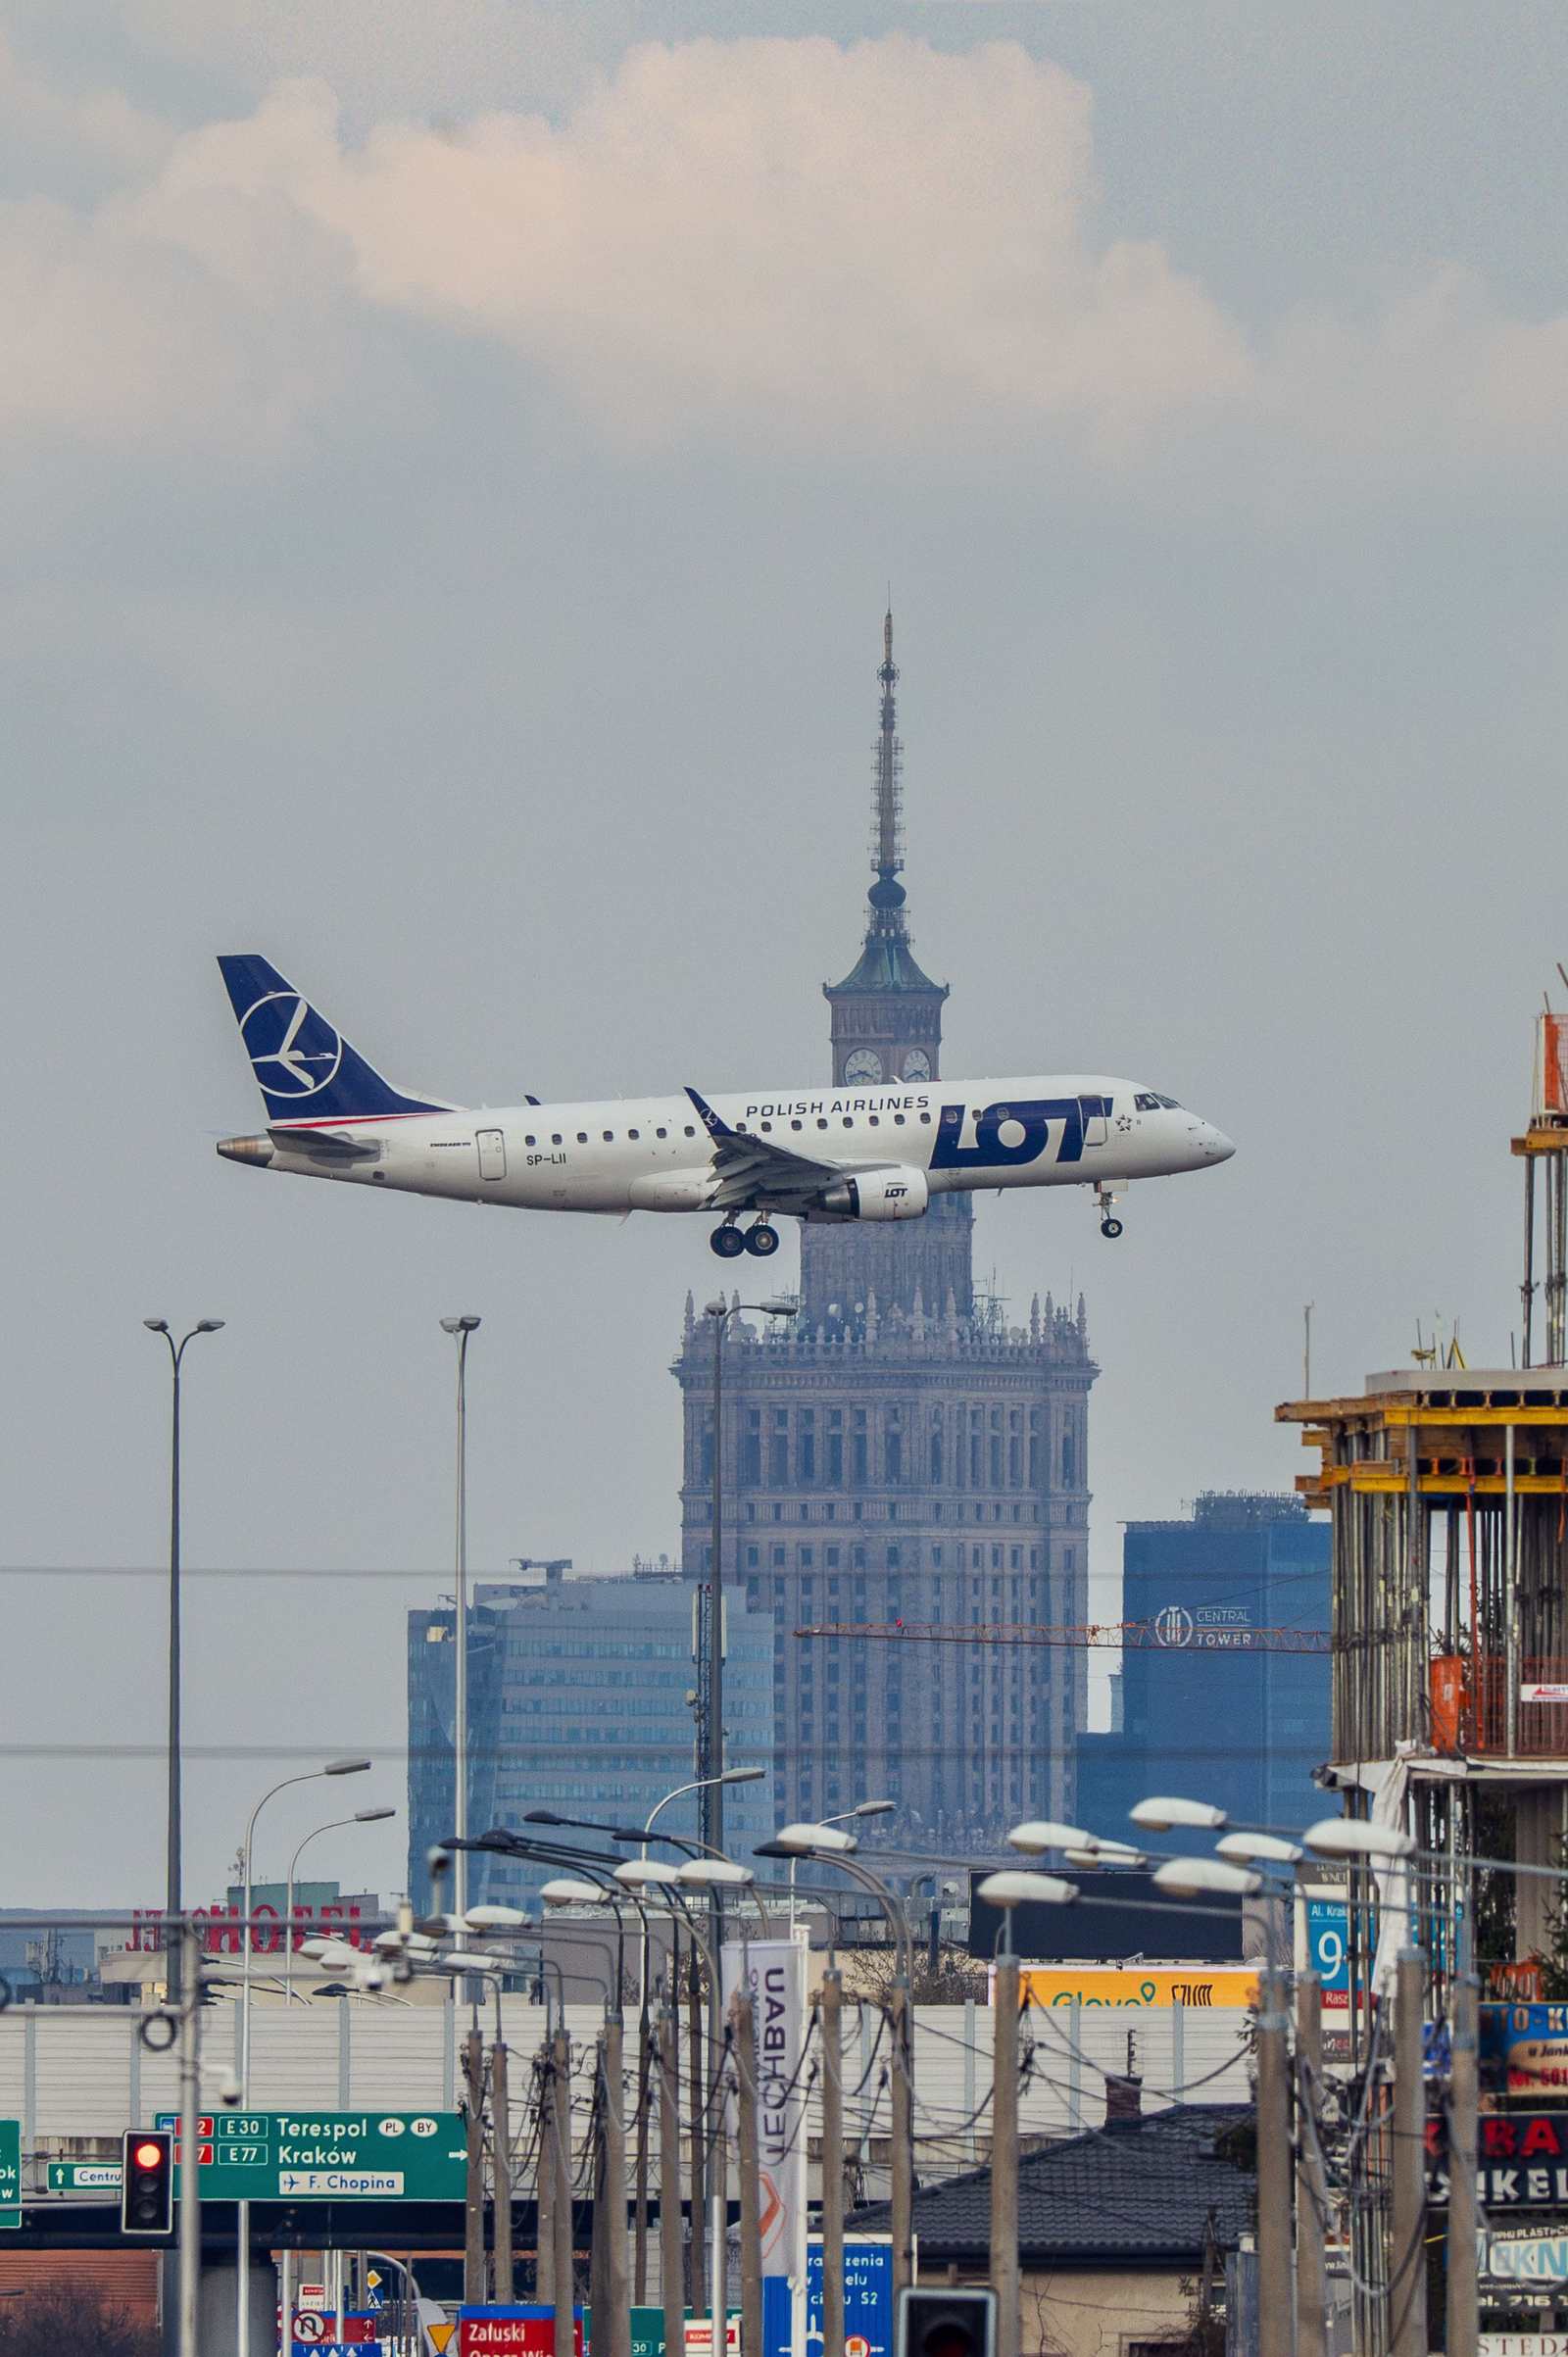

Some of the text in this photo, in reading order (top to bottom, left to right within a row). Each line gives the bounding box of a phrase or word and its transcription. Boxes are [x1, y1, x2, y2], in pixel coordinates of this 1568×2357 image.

[746, 1095, 930, 1118] POLISH AIRLINES
[929, 1097, 1113, 1169] LOT
[526, 1153, 566, 1165] SP-LII
[884, 1187, 908, 1198] LOT
[1197, 1608, 1251, 1622] CENTRAL
[1197, 1633, 1251, 1645] TOWER
[226, 2121, 235, 2134] E
[240, 2121, 260, 2135] 30
[276, 2118, 368, 2142] Terespol
[385, 2122, 399, 2134] PL
[417, 2122, 432, 2134] BY
[229, 2147, 238, 2162] E
[241, 2147, 258, 2163] 77
[278, 2145, 357, 2165] Kraków
[79, 2171, 121, 2182] Centru
[309, 2175, 396, 2191] F. Chopina
[860, 2291, 878, 2304] S2
[468, 2323, 525, 2342] Załuski
